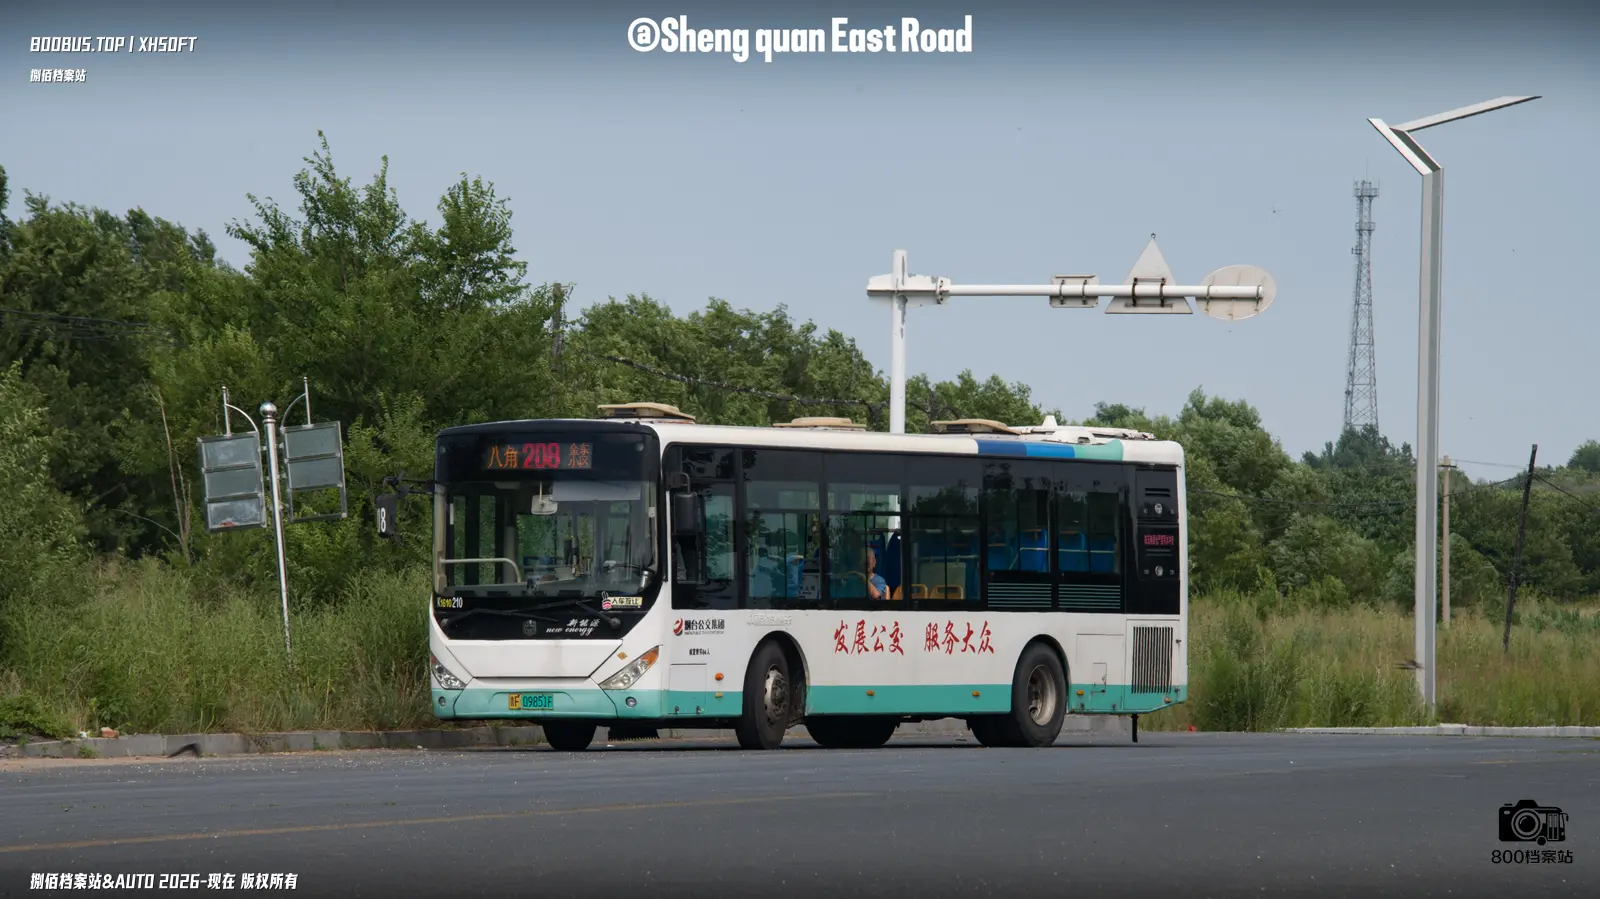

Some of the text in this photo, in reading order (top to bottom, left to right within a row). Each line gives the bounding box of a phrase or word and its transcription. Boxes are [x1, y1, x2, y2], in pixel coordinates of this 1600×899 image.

[488, 443, 560, 469] 八角 208
[565, 626, 594, 636] energy
[834, 619, 904, 655] 发展公交
[924, 620, 994, 655] 服务大众
[522, 695, 553, 708] 09851F
